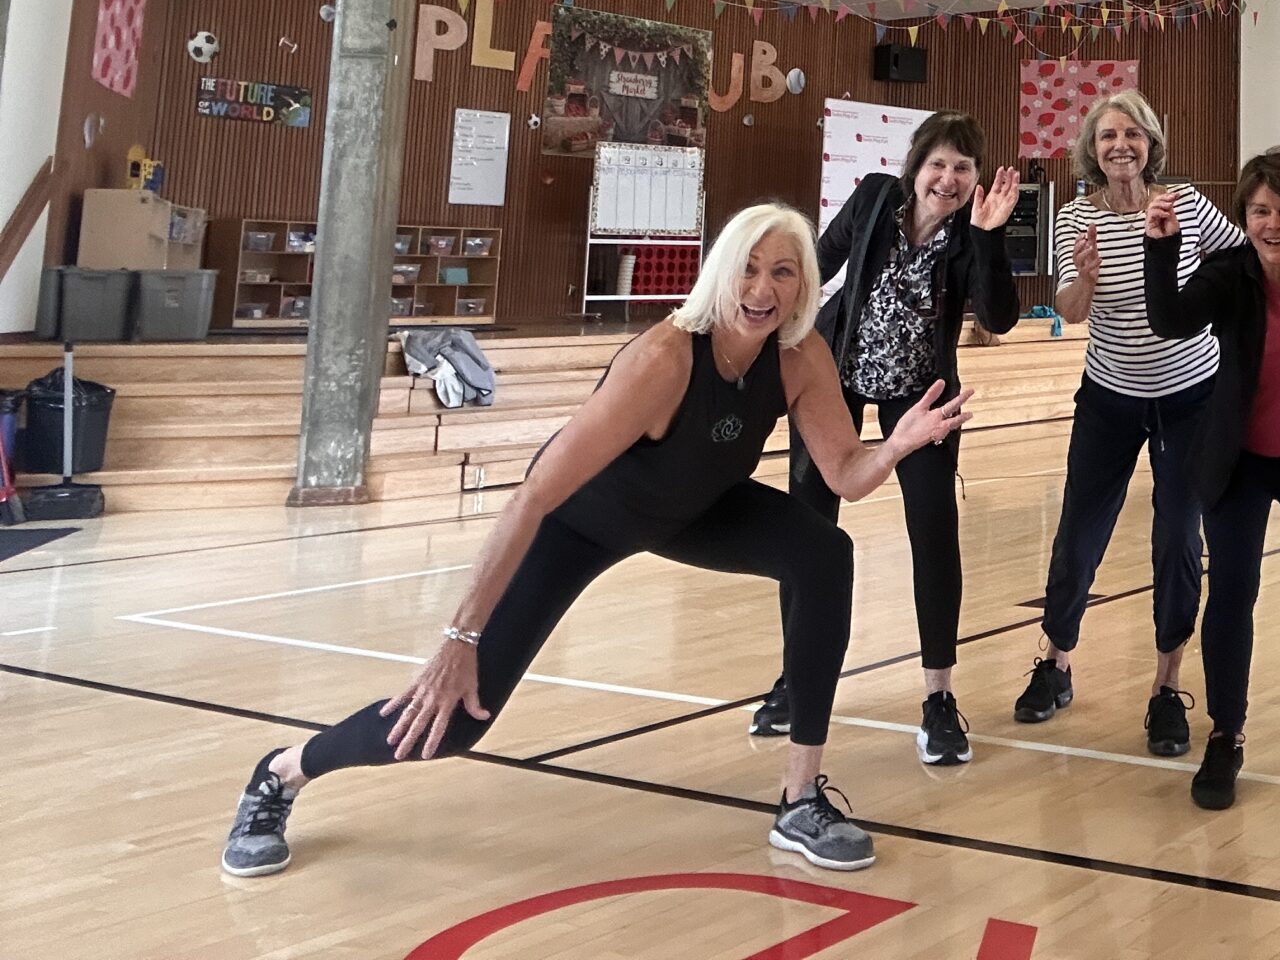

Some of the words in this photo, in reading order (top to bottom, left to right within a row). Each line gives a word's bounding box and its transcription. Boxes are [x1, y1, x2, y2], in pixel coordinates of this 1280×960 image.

[201, 77, 216, 91] THE
[216, 79, 276, 105] FUTURE
[621, 83, 646, 96] Market
[198, 100, 210, 108] OF
[211, 101, 275, 121] WORLD
